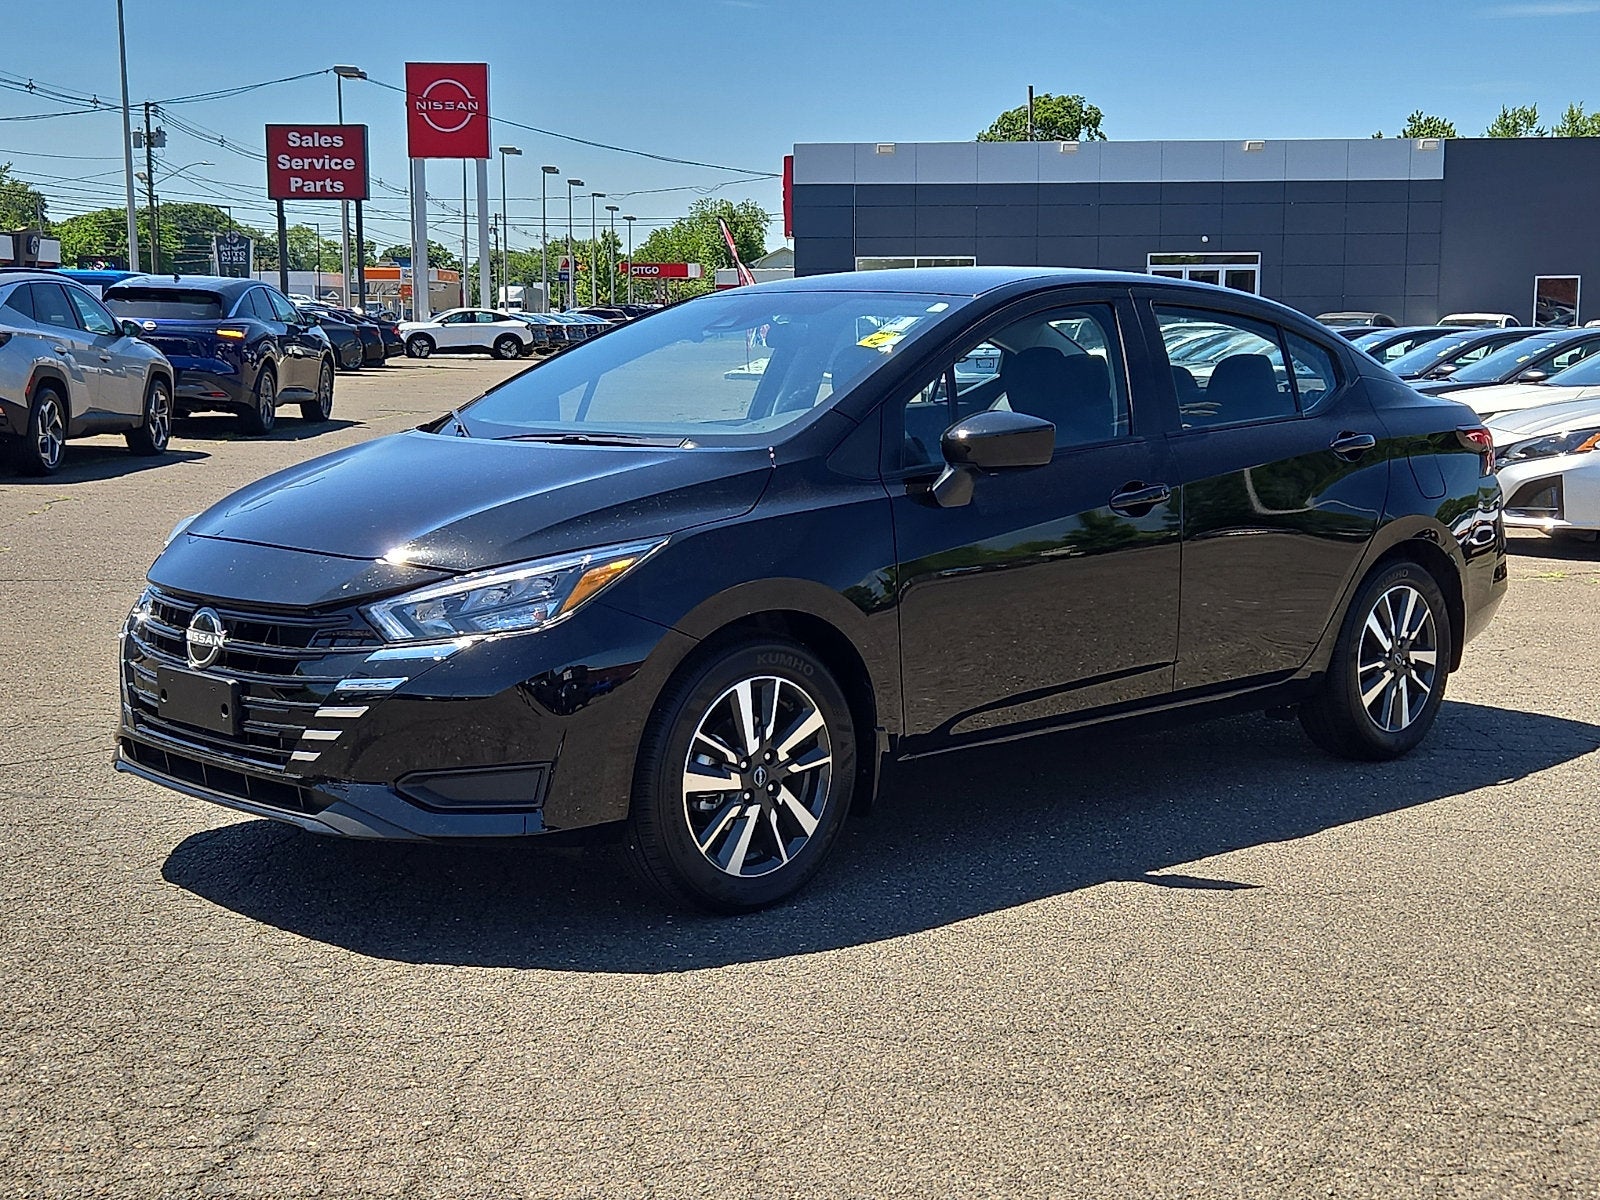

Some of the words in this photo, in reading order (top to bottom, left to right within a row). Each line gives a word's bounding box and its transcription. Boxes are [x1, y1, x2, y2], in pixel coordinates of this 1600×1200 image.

[416, 101, 478, 110] NISSAN
[287, 131, 344, 147] Sales
[277, 154, 355, 170] Service
[290, 177, 345, 192] Parts
[631, 266, 660, 275] CITGO
[756, 652, 814, 677] KUMHO
